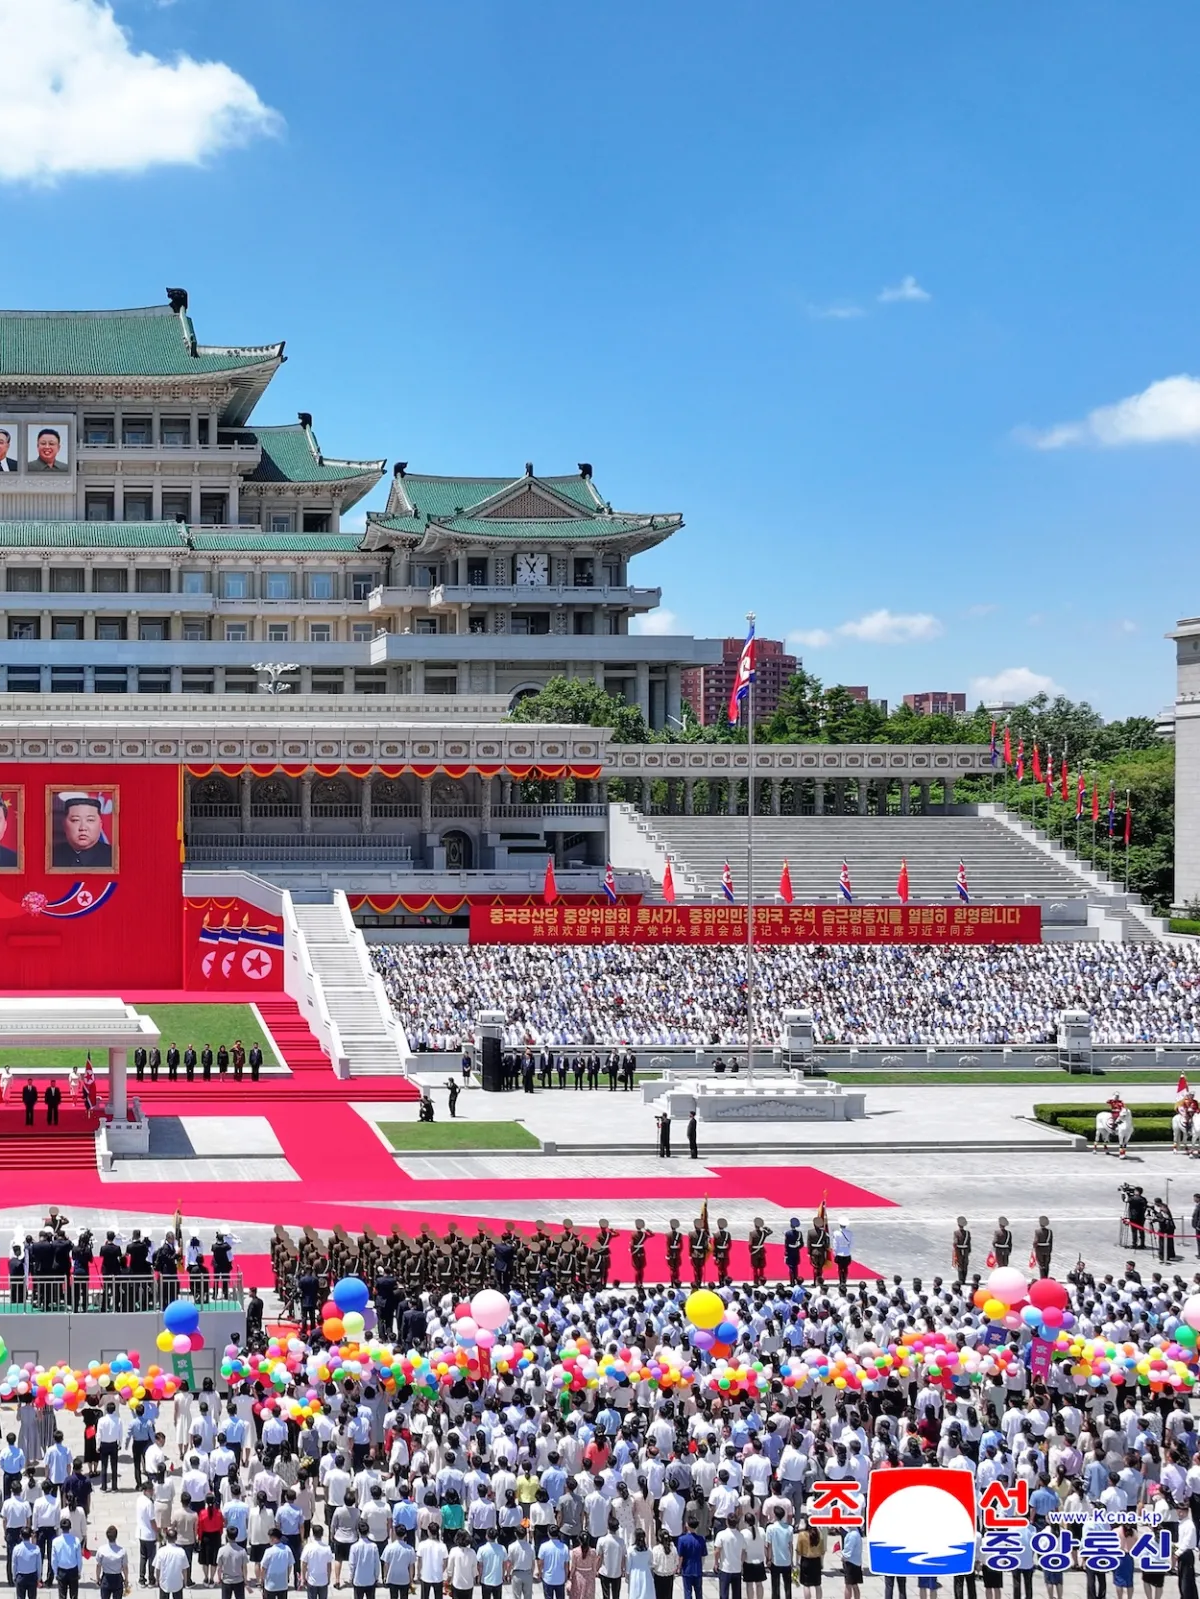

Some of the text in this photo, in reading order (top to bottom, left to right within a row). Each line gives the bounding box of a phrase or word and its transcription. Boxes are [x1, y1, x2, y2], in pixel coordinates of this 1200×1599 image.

[489, 908, 559, 925] 중국공산당
[563, 908, 631, 925] 중앙위원회
[688, 907, 784, 925] 중화인민공화국
[788, 908, 817, 925] 주석
[821, 908, 903, 925] 습근평동지를
[908, 908, 948, 925] 열렬히
[953, 907, 1021, 925] 환영합니다
